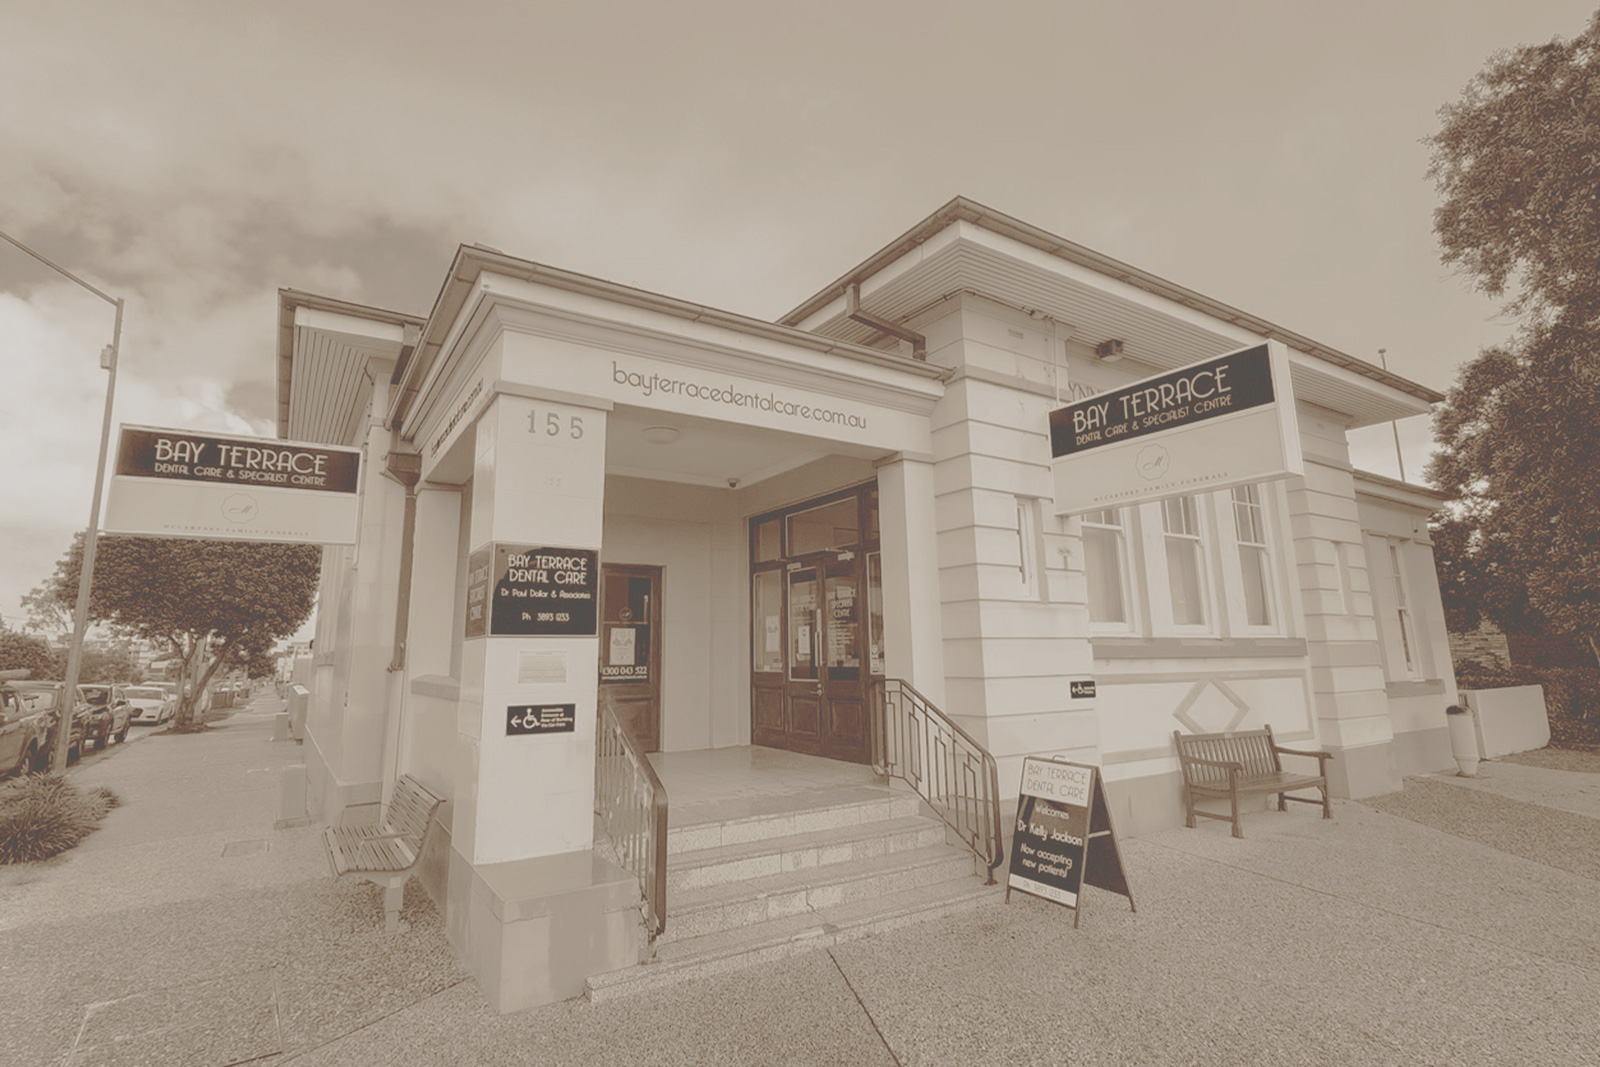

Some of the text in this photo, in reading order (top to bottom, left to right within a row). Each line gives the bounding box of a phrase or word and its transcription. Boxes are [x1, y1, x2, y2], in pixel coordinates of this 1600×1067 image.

[611, 360, 867, 430] bayterracedentalcare.com.au
[1073, 365, 1232, 434] BAY TERRACE
[527, 409, 585, 440] 155
[1075, 395, 1233, 446] DENTAL CARE & SPECIALIST CENTRE
[154, 438, 329, 476] BAY TERRACE
[154, 462, 326, 487] DENTAL CARE & SPECIALIST CENTRE
[1144, 482, 1176, 493] FAMILY
[1180, 471, 1230, 486] FUNERALS
[225, 527, 260, 535] FAMILY
[264, 529, 310, 537] FUNERALS
[508, 554, 588, 571] BAY TERRACE
[509, 568, 587, 585] DENTAL CARE
[501, 588, 509, 596] Dr
[512, 588, 527, 597] Paul
[550, 590, 557, 599] &
[522, 612, 531, 621] Ph
[1027, 763, 1087, 785] BAY TERRACE
[1026, 778, 1085, 800] DENTAL CARE
[1034, 802, 1069, 820] Welcomes
[1017, 819, 1083, 847] Dr Kelly Jackson
[1020, 843, 1073, 870] Now accepting
[1022, 859, 1036, 869] new
